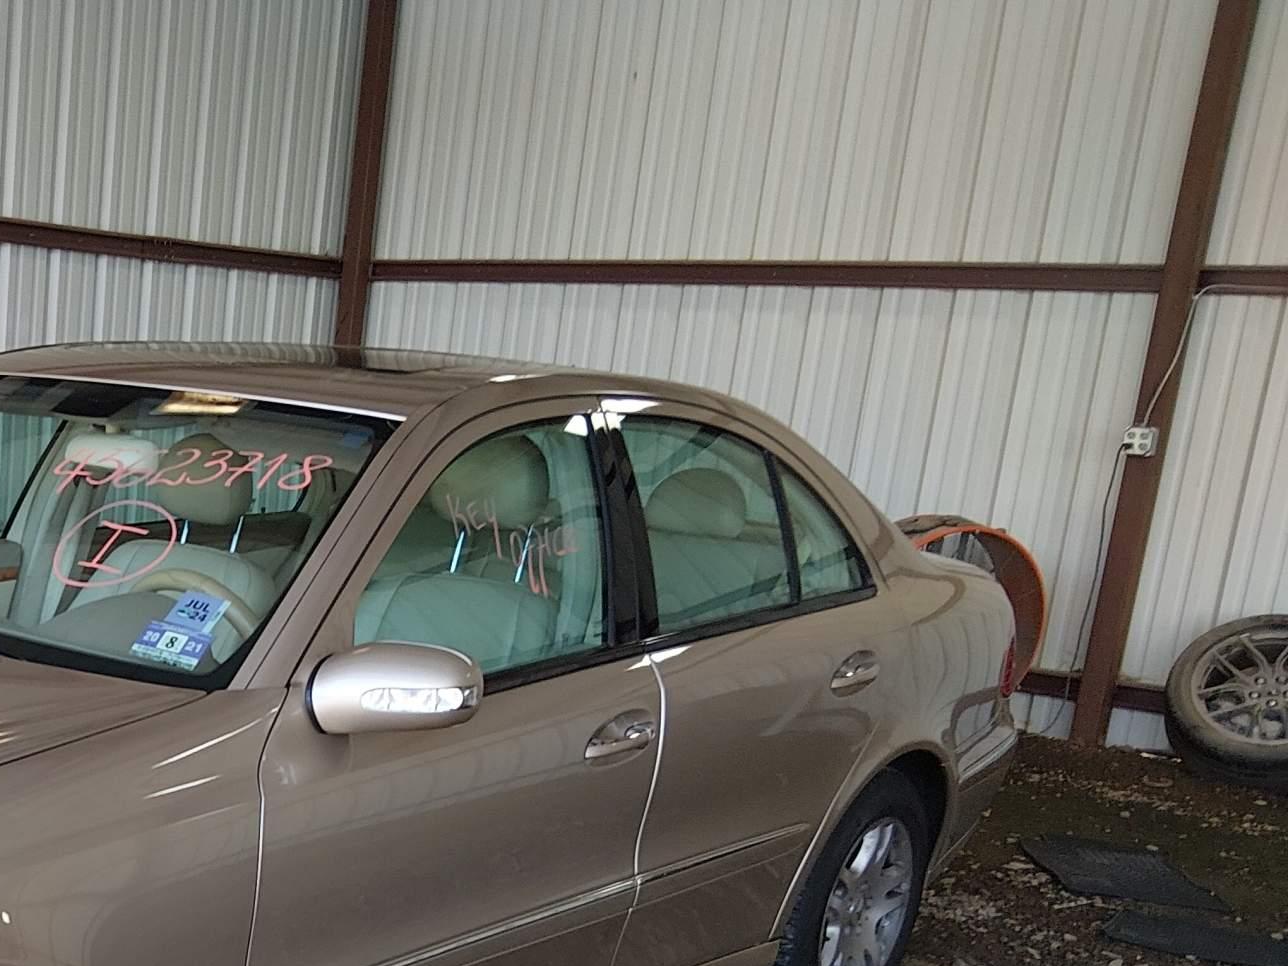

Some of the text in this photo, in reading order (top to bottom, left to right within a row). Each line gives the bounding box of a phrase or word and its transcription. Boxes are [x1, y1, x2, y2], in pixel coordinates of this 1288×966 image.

[54, 448, 333, 494] 45623718
[446, 493, 502, 560] KEY
[185, 600, 210, 613] JUL
[189, 611, 207, 622] 24
[143, 630, 203, 653] 20 8 21
